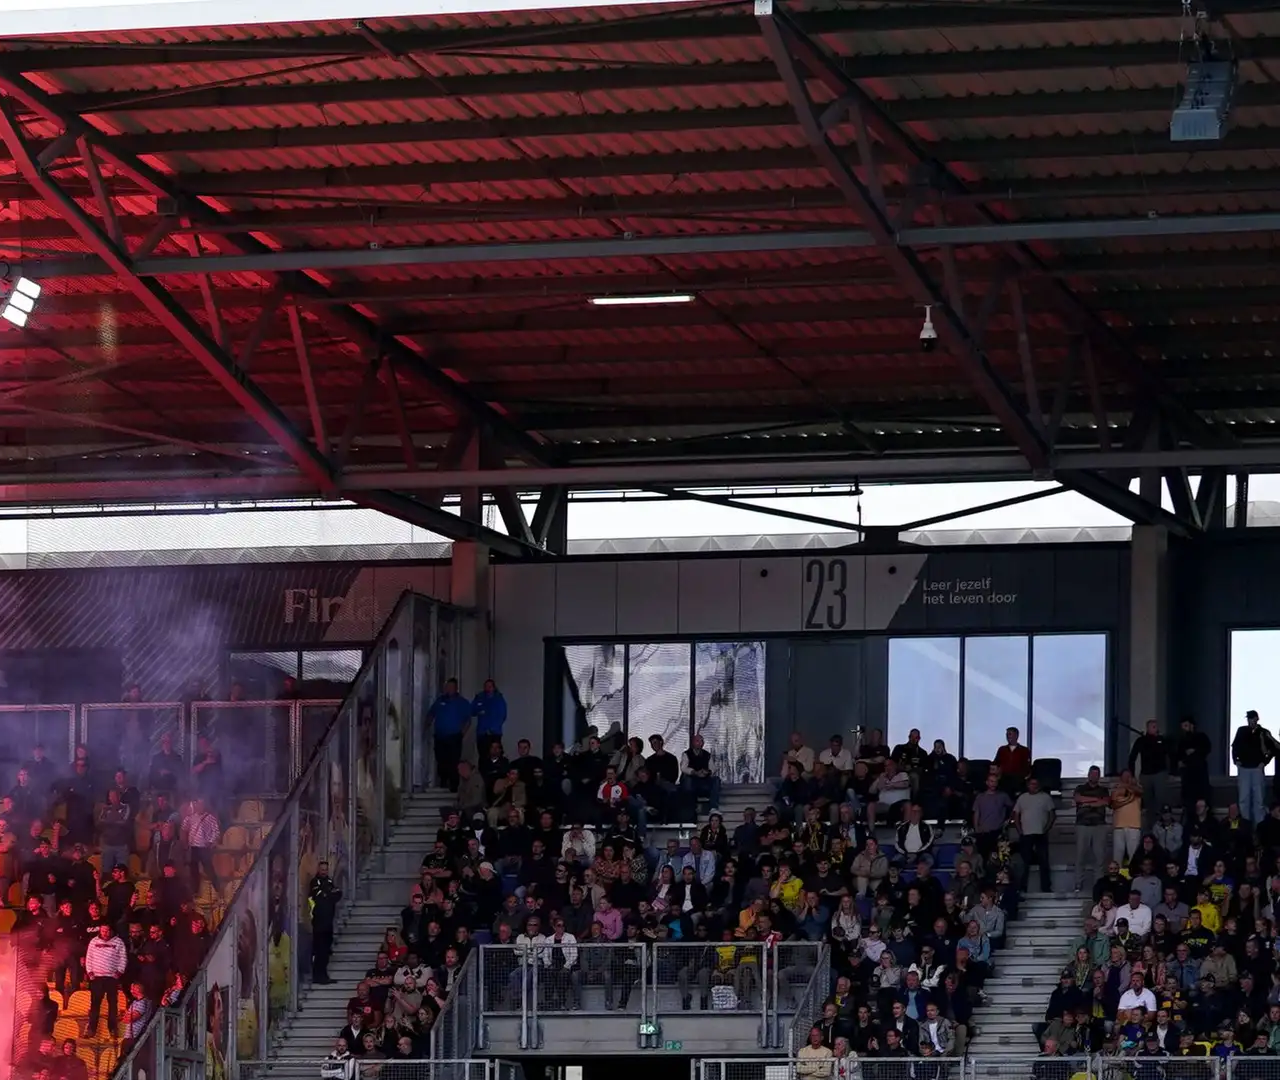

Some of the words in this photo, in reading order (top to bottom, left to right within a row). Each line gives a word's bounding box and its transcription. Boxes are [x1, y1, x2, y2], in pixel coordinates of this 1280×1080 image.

[922, 578, 951, 590] Leer
[955, 577, 992, 593] jezelf
[805, 559, 847, 630] 23
[922, 592, 945, 604] het
[949, 592, 984, 604] leven
[987, 591, 1018, 603] door
